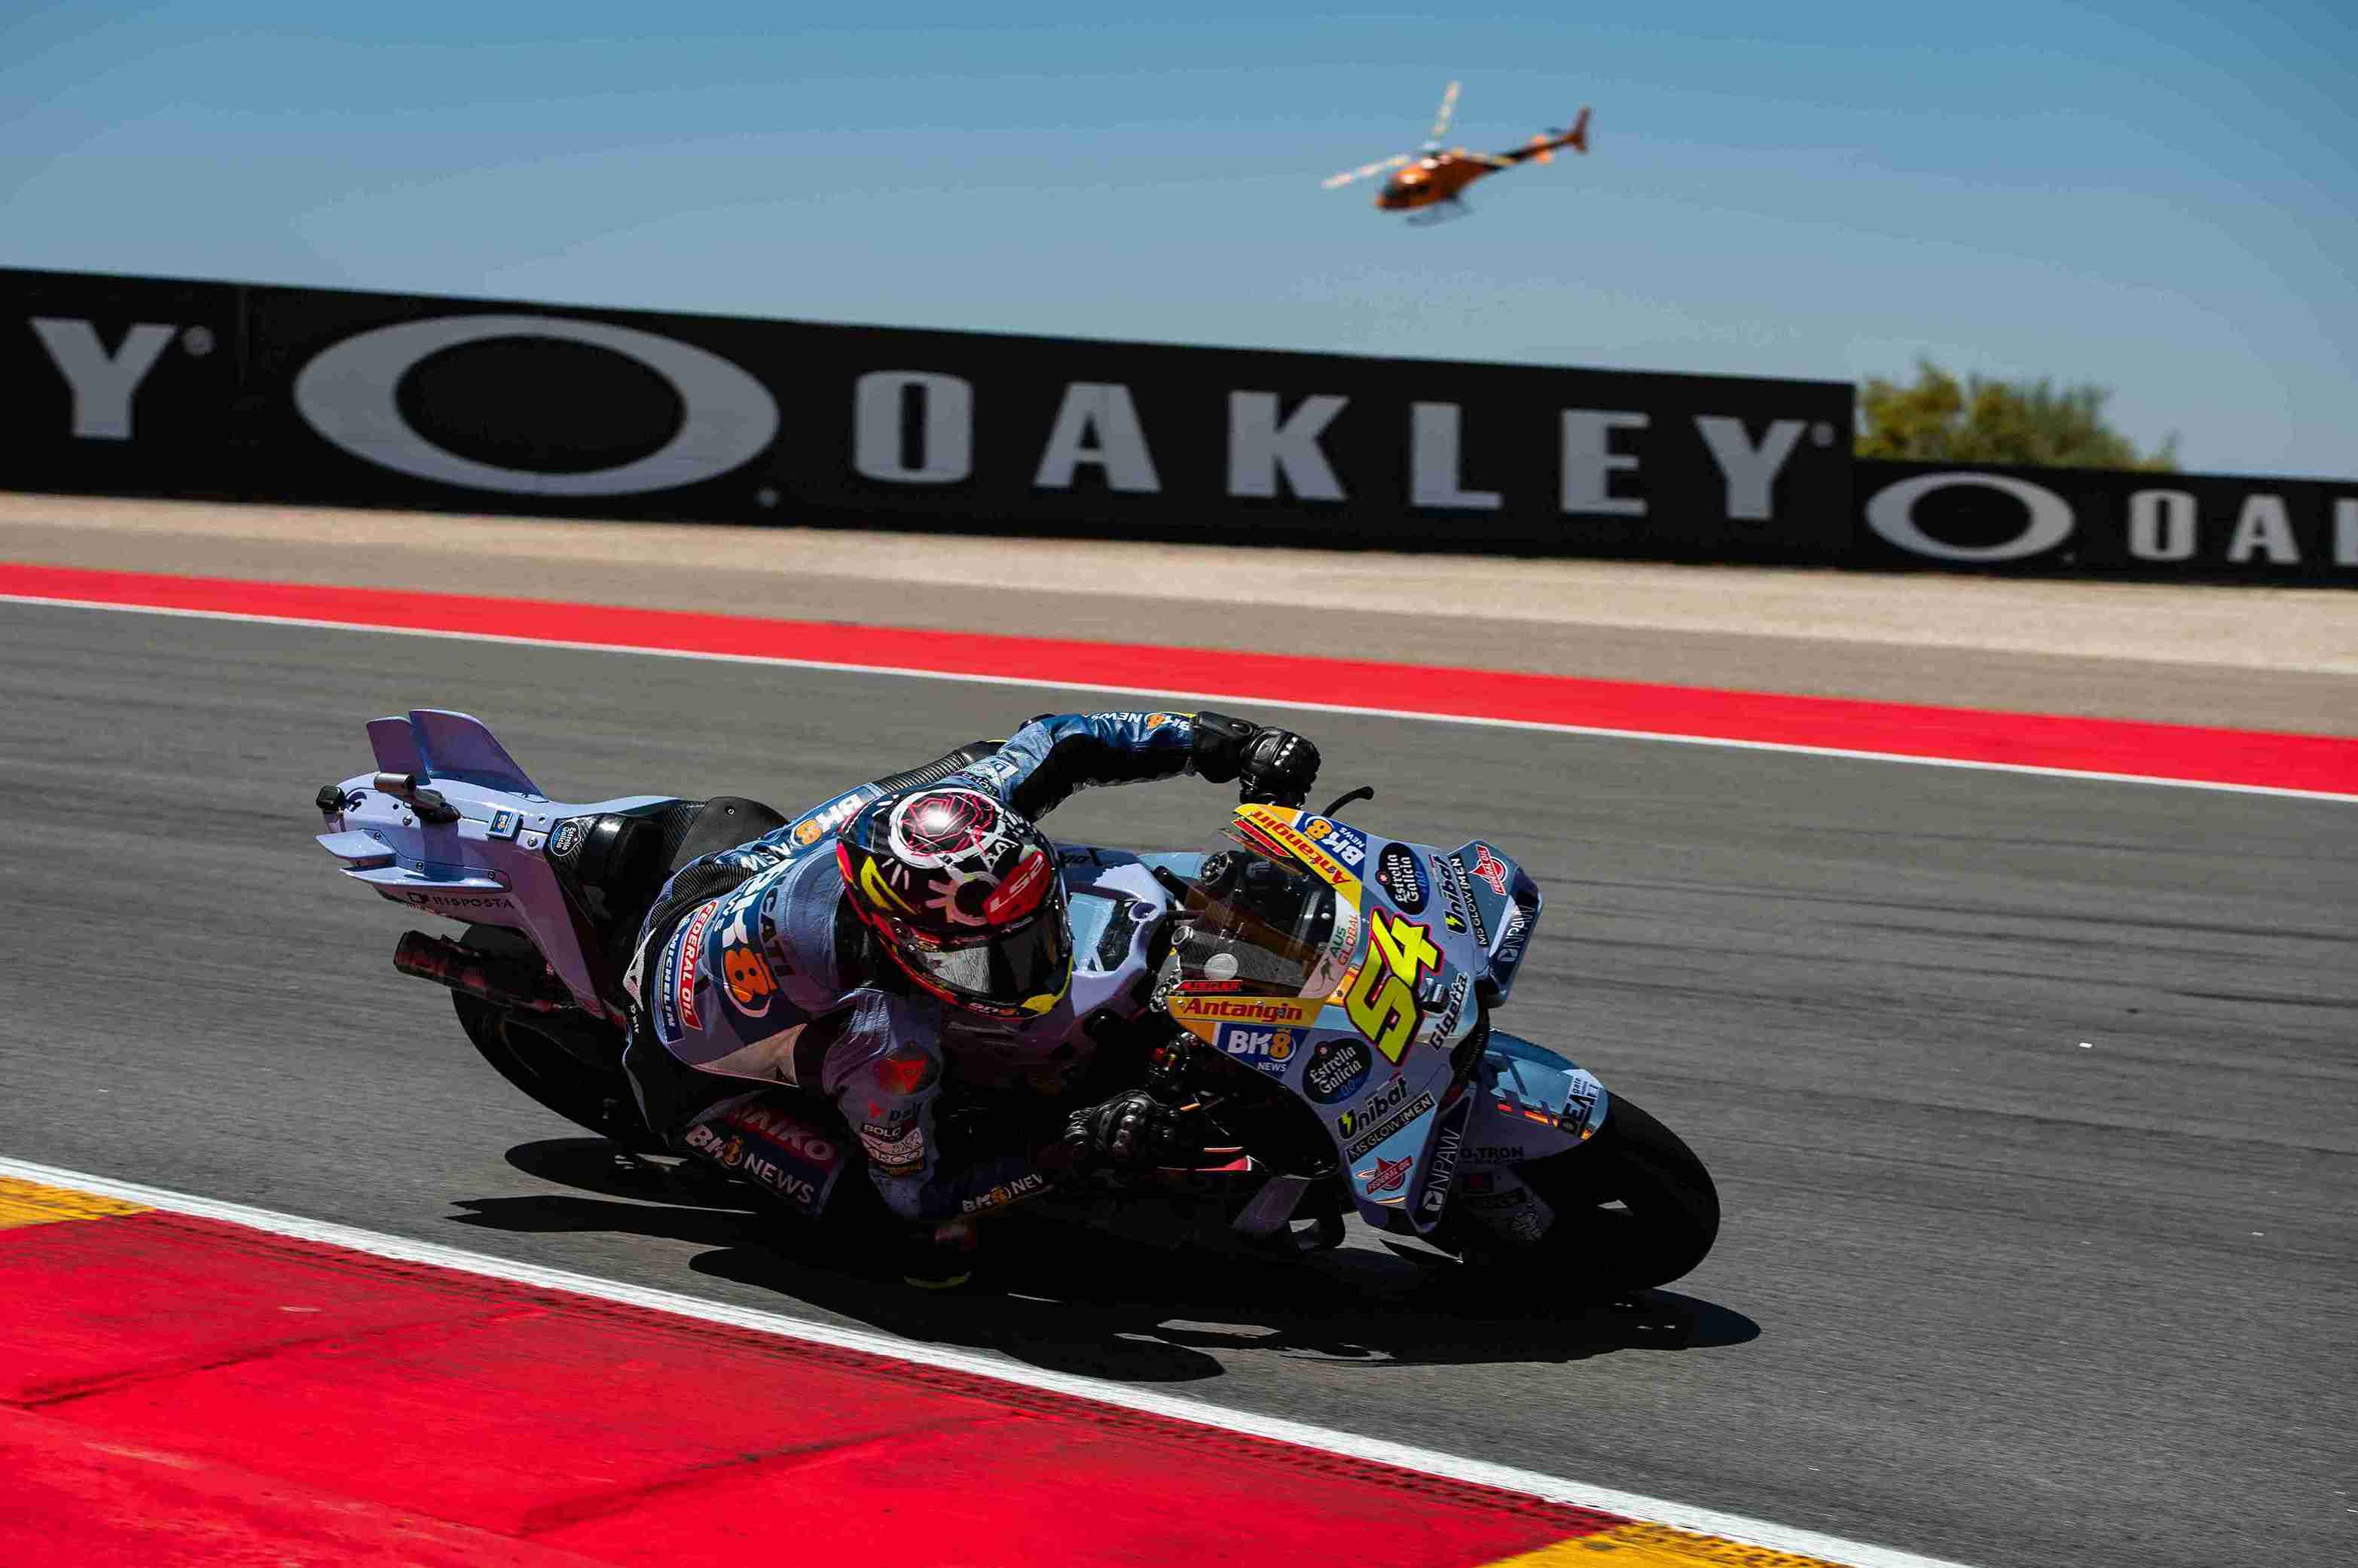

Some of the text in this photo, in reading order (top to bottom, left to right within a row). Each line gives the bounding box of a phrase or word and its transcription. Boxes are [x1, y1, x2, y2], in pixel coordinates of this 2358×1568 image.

[853, 370, 1807, 520] OAKLEY
[740, 842, 792, 871] NEW
[1253, 810, 1352, 885] Antangin
[1305, 816, 1366, 866] BK8
[1339, 827, 1365, 849] NEWS
[1387, 853, 1408, 903] Estrella
[1400, 856, 1420, 902] Galicia
[681, 901, 715, 1019] FEDERAL OIL
[1330, 926, 1347, 958] AUS
[1337, 914, 1358, 966] GLOBAL
[663, 933, 680, 1027] MICHELIN
[1344, 908, 1442, 1065] 54
[1184, 998, 1303, 1023] Antangin
[1430, 972, 1468, 1050] Gigetta
[1228, 1029, 1294, 1060] BK8
[1257, 1062, 1287, 1072] NEWS
[1310, 1046, 1357, 1084] Estrella
[1319, 1059, 1362, 1094] Galicia
[1367, 1120, 1400, 1146] GLOW
[1403, 1097, 1432, 1121] MEN
[744, 1152, 814, 1204] NEWS
[1428, 1127, 1461, 1192] NPAW
